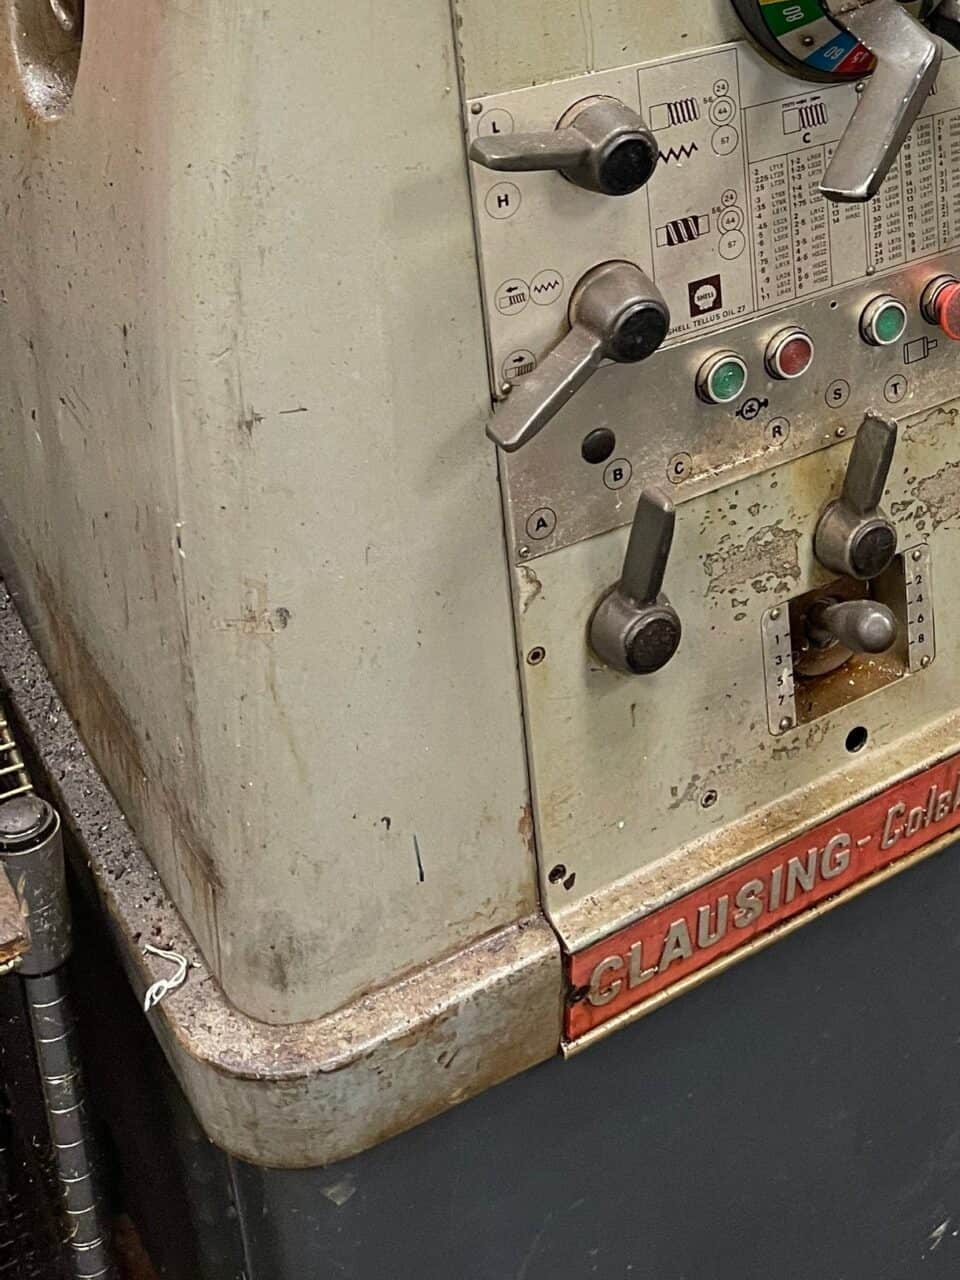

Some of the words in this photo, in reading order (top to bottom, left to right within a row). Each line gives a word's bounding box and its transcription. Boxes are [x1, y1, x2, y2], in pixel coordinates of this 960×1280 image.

[782, 5, 805, 23] 80
[491, 120, 500, 134] L
[802, 132, 811, 143] C
[496, 193, 510, 209] H
[667, 323, 691, 336] SHELL
[693, 313, 721, 328] TELLUS
[722, 309, 736, 318] OIL
[737, 304, 746, 313] 27
[833, 388, 843, 401] S
[891, 382, 901, 395] T
[771, 424, 783, 438] R
[674, 461, 685, 474] C
[613, 468, 623, 482] B
[535, 517, 548, 532] A
[914, 575, 923, 585] 2
[916, 593, 924, 603] 4
[917, 613, 925, 624] 6
[775, 634, 780, 645] 1
[917, 633, 925, 643] 8
[775, 656, 783, 665] 3
[777, 676, 784, 687] 5
[777, 695, 785, 706] 7
